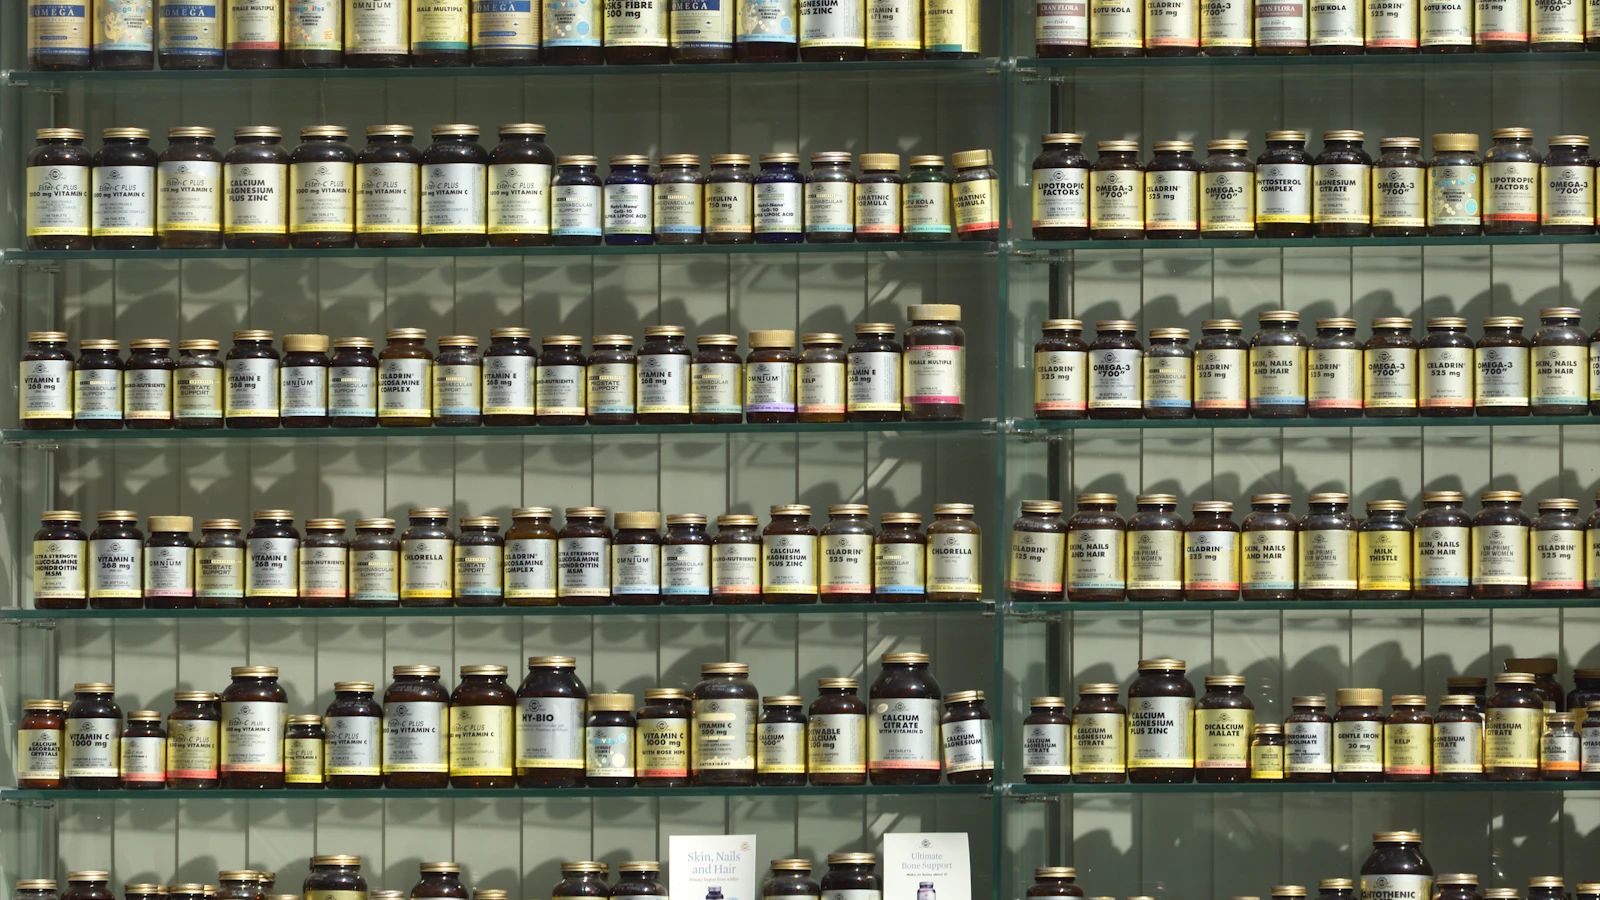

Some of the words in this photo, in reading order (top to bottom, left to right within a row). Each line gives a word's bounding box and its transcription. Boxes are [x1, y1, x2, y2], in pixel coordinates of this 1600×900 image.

[625, 1, 653, 9] FIBRE
[672, 2, 708, 10] OMEGA
[625, 11, 641, 19] mg
[813, 8, 833, 16] ZINC
[404, 553, 444, 561] CHLORELLA
[1205, 553, 1217, 562] mg
[522, 714, 554, 722] HY-BIO
[1204, 723, 1244, 731] DICALCIUM
[947, 734, 974, 742] CALCIUM
[822, 742, 835, 750] mg
[688, 852, 714, 863] Skin,
[716, 851, 741, 861] Nails
[692, 864, 714, 874] and
[717, 864, 736, 874] Hair
[902, 861, 920, 869] Bone
[922, 861, 952, 871] Support
